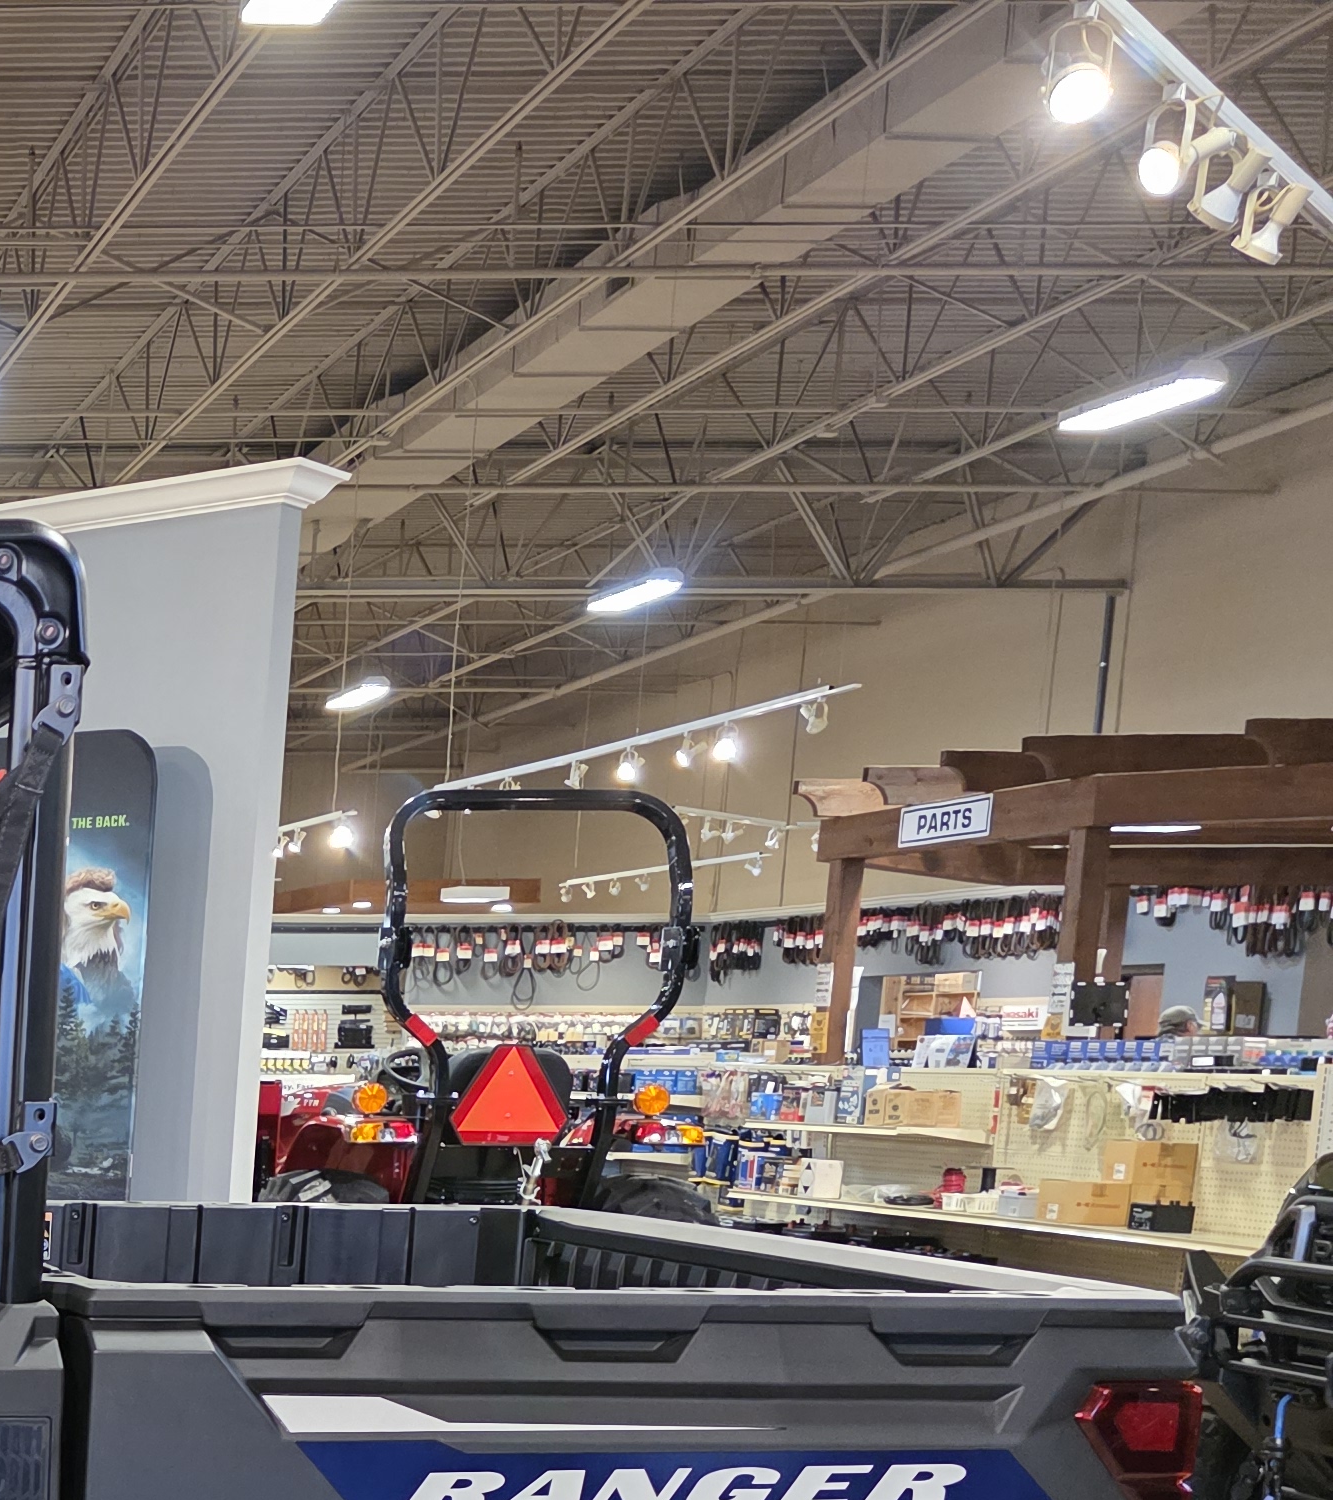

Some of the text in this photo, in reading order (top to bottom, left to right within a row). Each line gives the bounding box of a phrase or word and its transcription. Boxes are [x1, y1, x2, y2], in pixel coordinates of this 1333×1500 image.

[71, 816, 93, 829] THE
[96, 814, 131, 828] BACK.
[916, 807, 973, 836] PARTS
